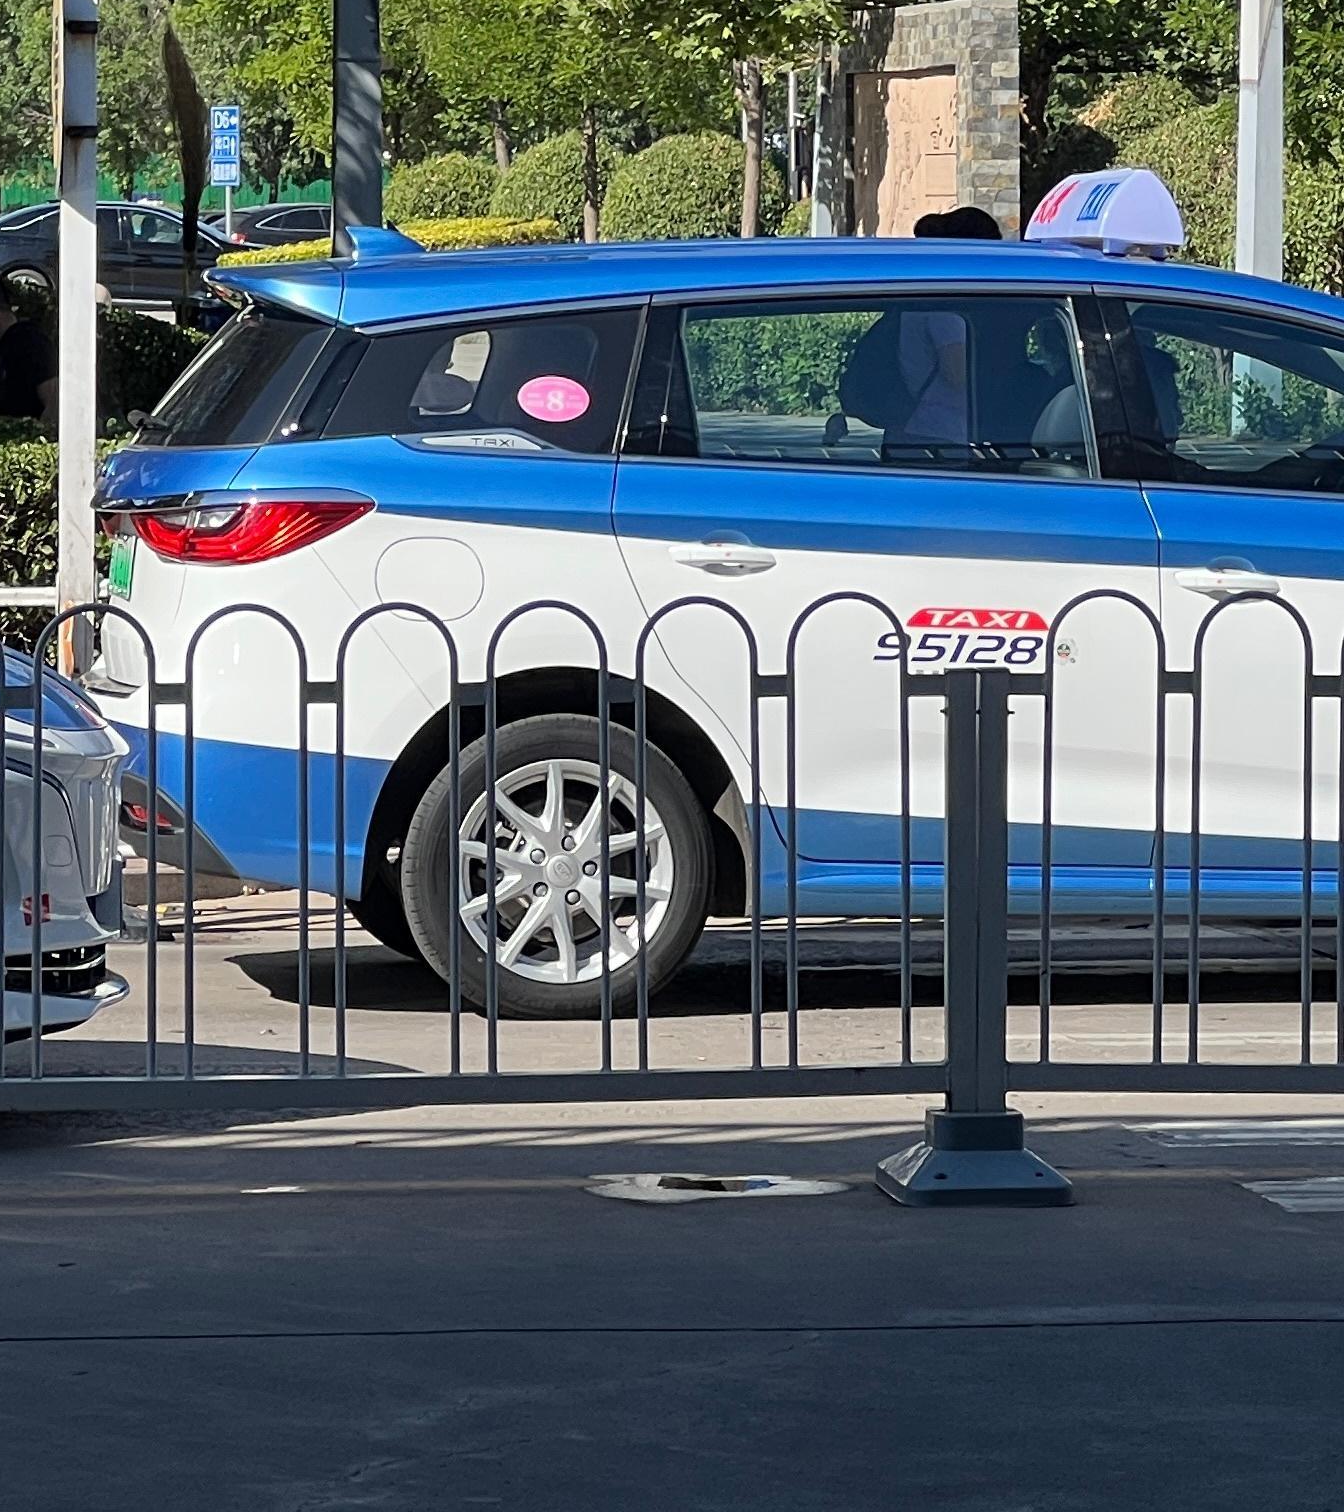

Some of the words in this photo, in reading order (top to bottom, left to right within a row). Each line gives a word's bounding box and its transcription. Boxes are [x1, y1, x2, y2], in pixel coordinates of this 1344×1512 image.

[471, 437, 515, 447] TAXI
[925, 609, 1029, 629] TAXI
[872, 633, 1044, 665] 95128
